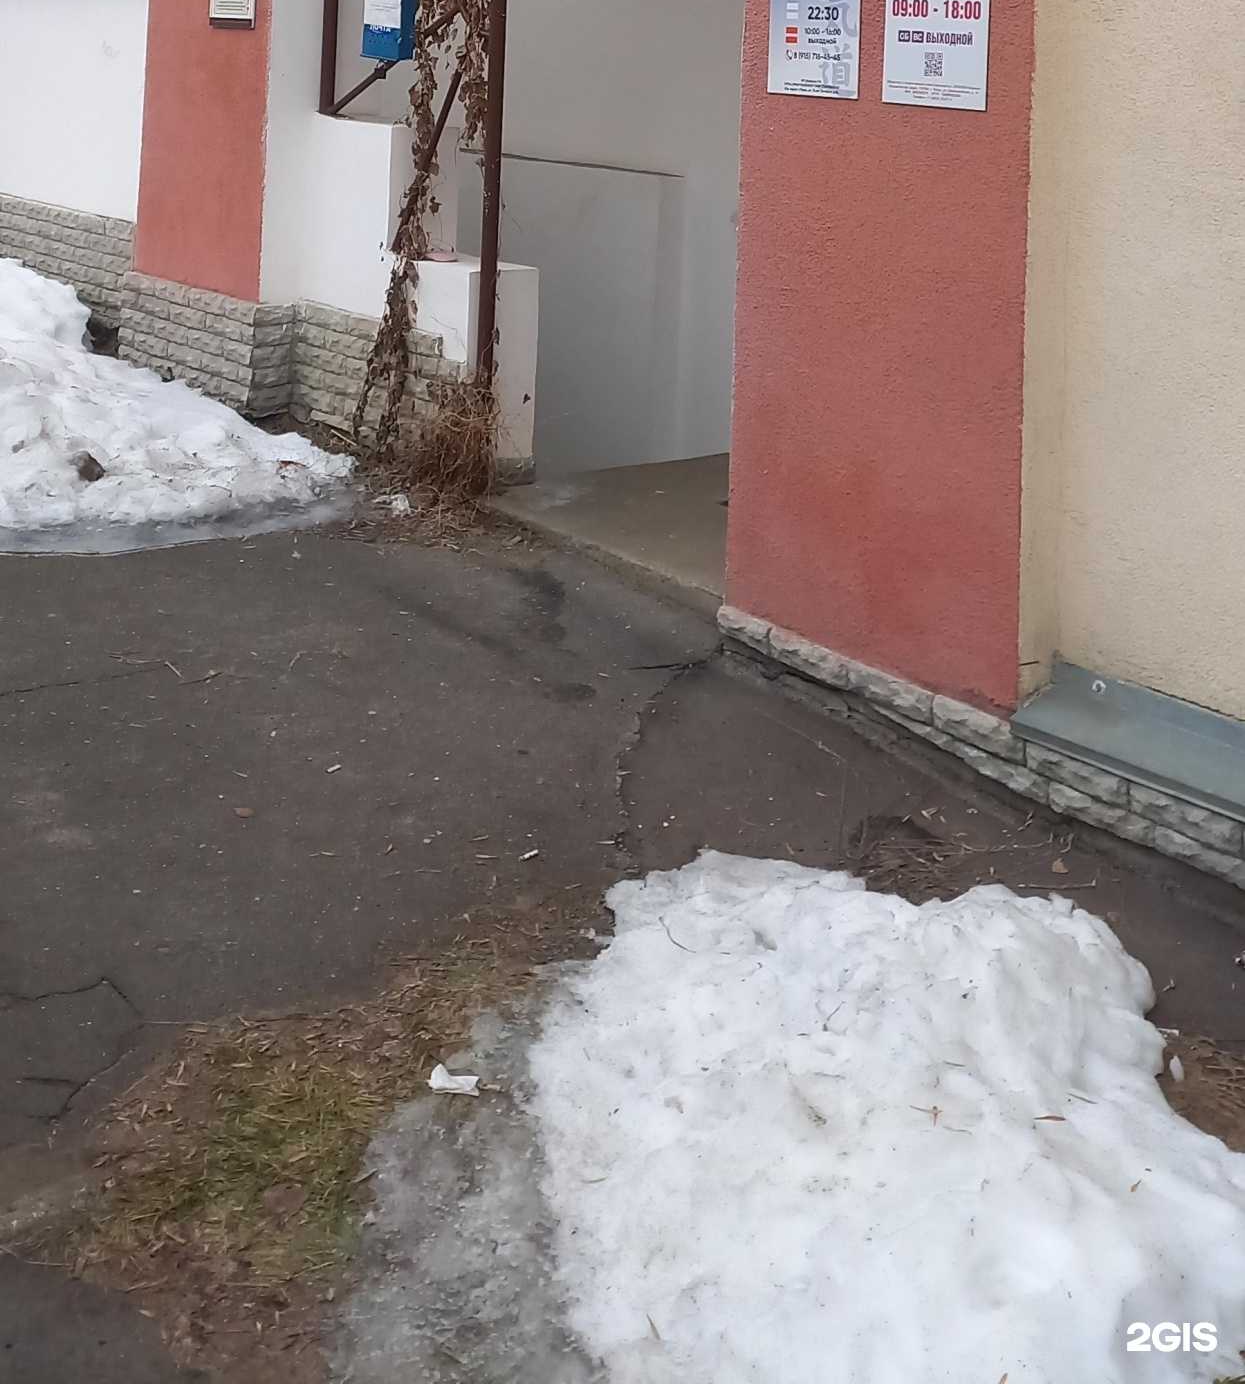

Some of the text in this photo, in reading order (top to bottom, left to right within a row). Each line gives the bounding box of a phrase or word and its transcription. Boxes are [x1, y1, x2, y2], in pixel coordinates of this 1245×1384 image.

[808, 7, 839, 20] 22:30
[892, 0, 928, 17] 09:00
[944, 0, 981, 20] 18:00
[926, 32, 973, 45] ВЫХОДНОЙ
